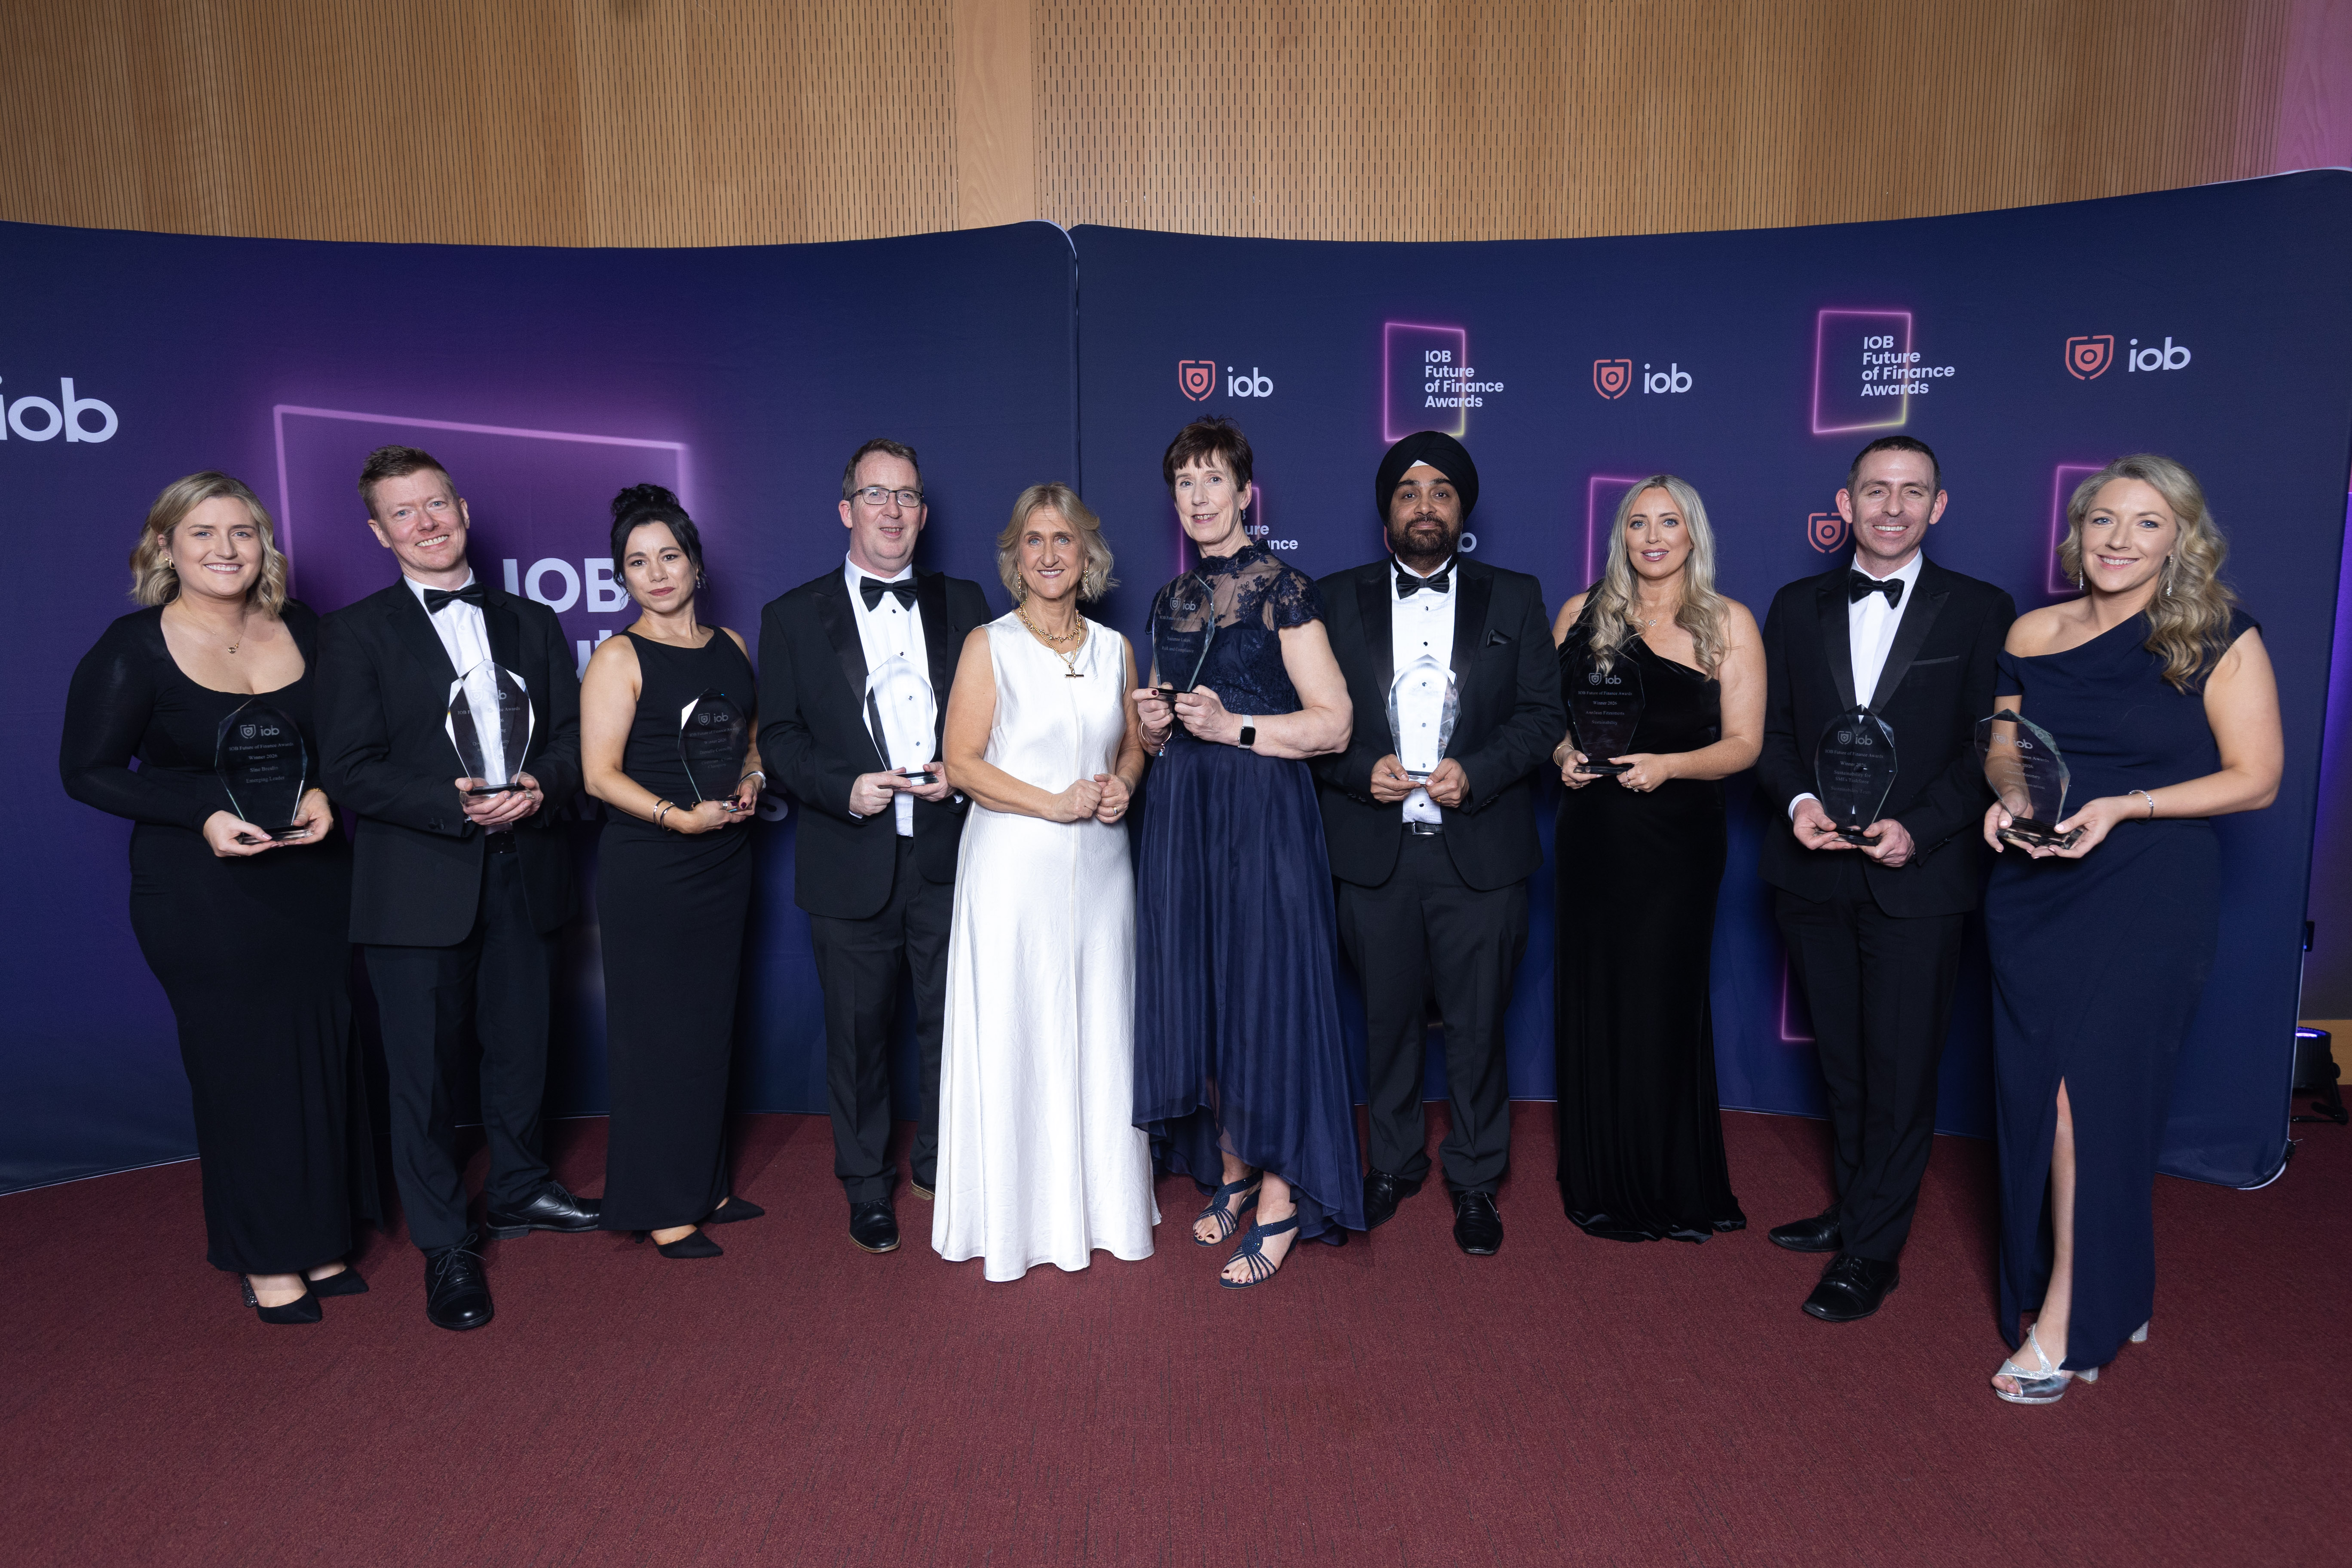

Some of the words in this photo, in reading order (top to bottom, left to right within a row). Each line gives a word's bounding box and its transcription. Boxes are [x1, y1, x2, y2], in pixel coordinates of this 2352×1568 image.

[1864, 335, 1894, 349] IOB
[1425, 350, 1451, 363] IOB
[1862, 351, 1921, 365] Future
[2128, 335, 2191, 373] iob
[1425, 365, 1475, 378] Future
[1644, 362, 1693, 394] iob
[1862, 367, 1880, 381] of
[1883, 366, 1955, 380] Finance
[1227, 366, 1274, 398] iob
[1425, 379, 1441, 393] of
[1443, 380, 1504, 393] Finance
[1861, 380, 1929, 396] Awards
[1425, 395, 1483, 408] Awards
[1245, 525, 1270, 536] ure
[503, 557, 630, 614] IOB
[1183, 600, 1196, 610] iob
[1605, 675, 1621, 684] iob
[714, 712, 729, 723] iob
[260, 725, 280, 736] iob
[1855, 734, 1872, 745] iob
[2012, 738, 2033, 749] iob
